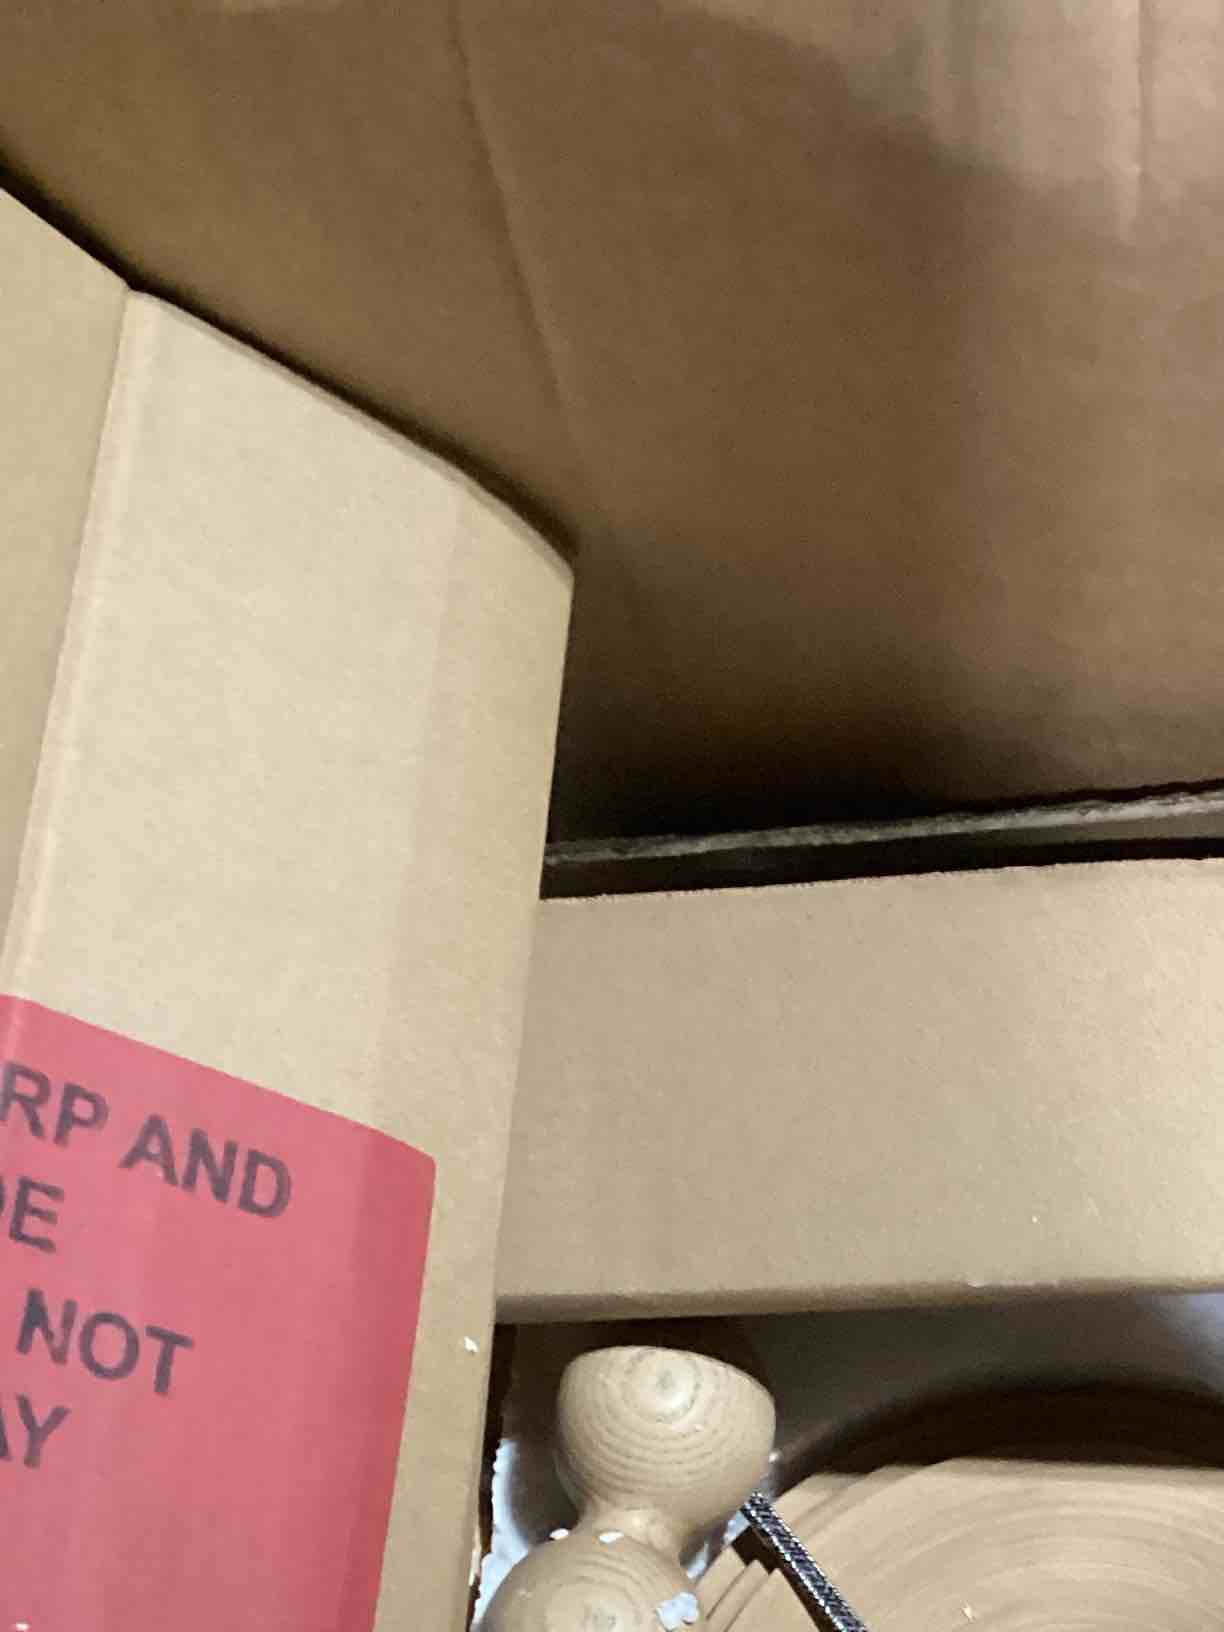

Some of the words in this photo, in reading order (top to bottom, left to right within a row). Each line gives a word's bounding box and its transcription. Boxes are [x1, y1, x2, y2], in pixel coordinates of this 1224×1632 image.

[0, 1176, 65, 1254] E
[120, 1114, 292, 1219] AND
[16, 1287, 193, 1395] NOT
